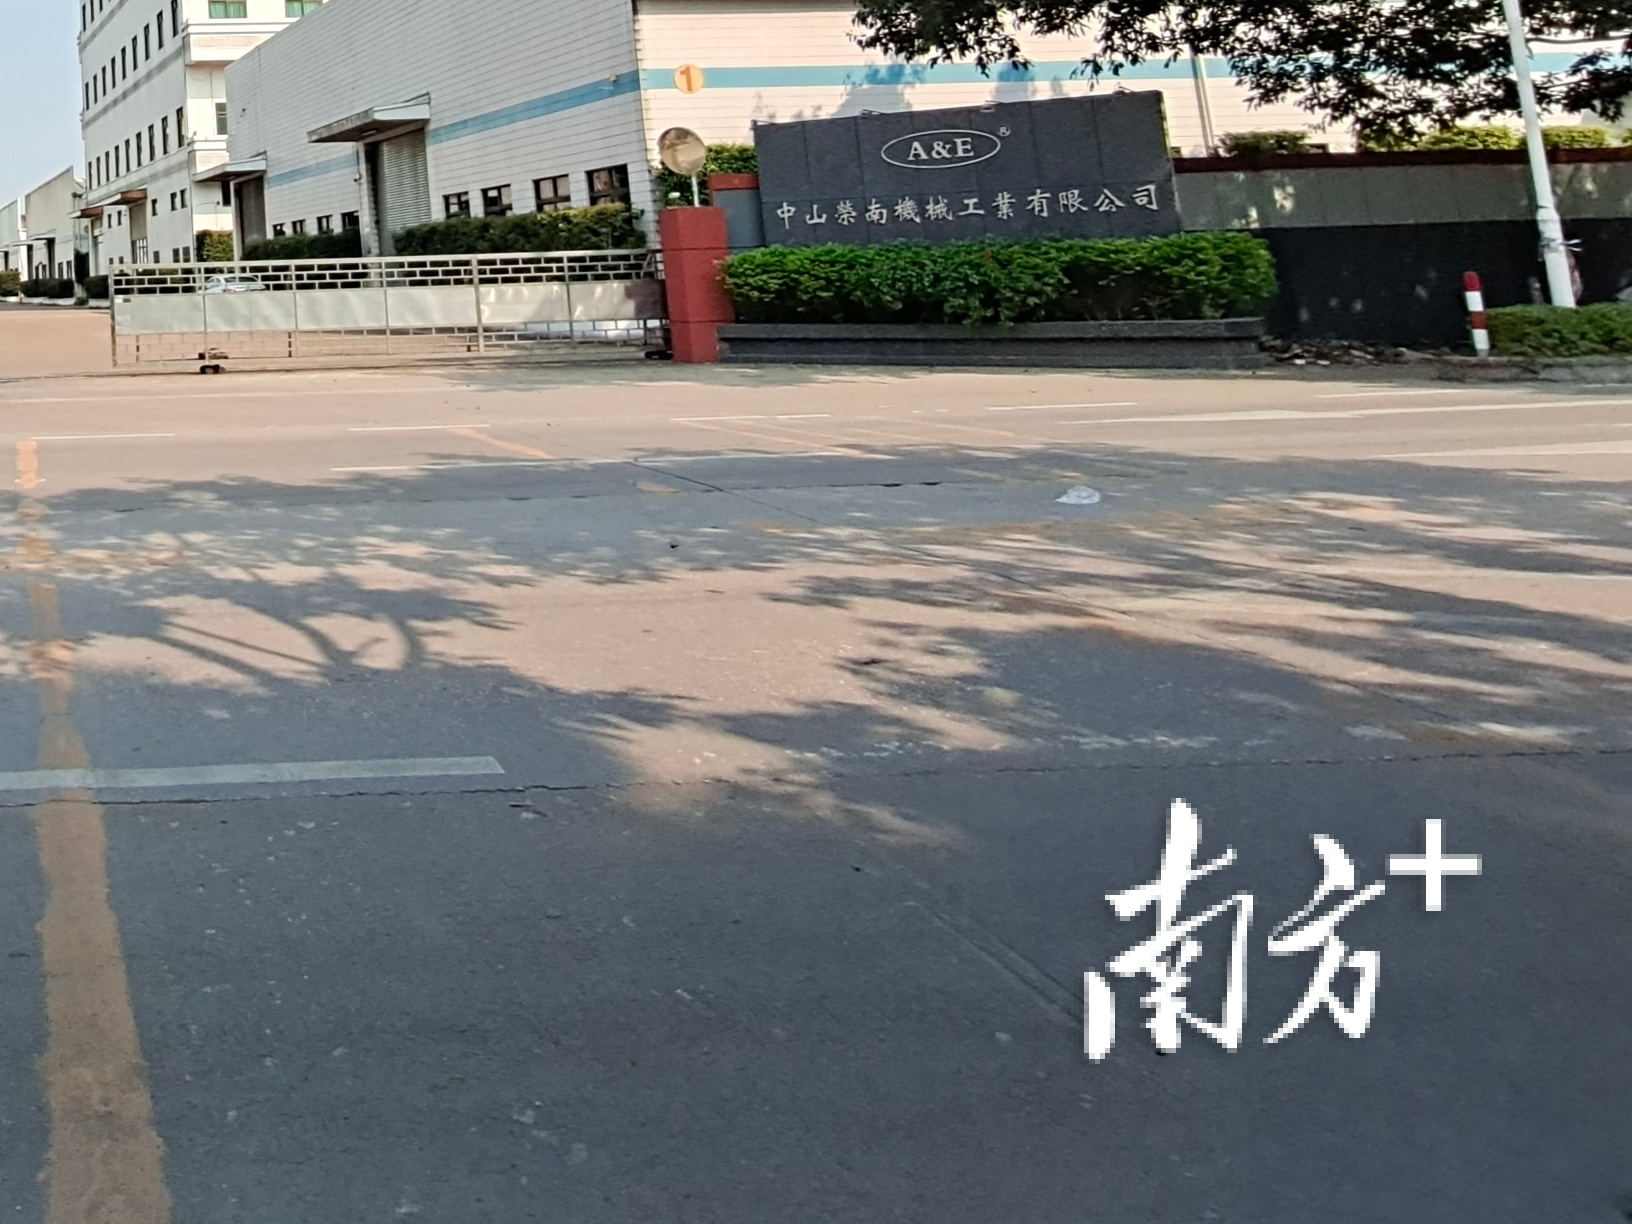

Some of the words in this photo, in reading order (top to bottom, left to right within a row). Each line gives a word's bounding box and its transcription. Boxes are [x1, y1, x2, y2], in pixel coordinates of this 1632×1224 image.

[680, 66, 692, 91] 1
[907, 137, 975, 161] A&E
[776, 183, 1160, 230] 中山榮南機械工業有限公司
